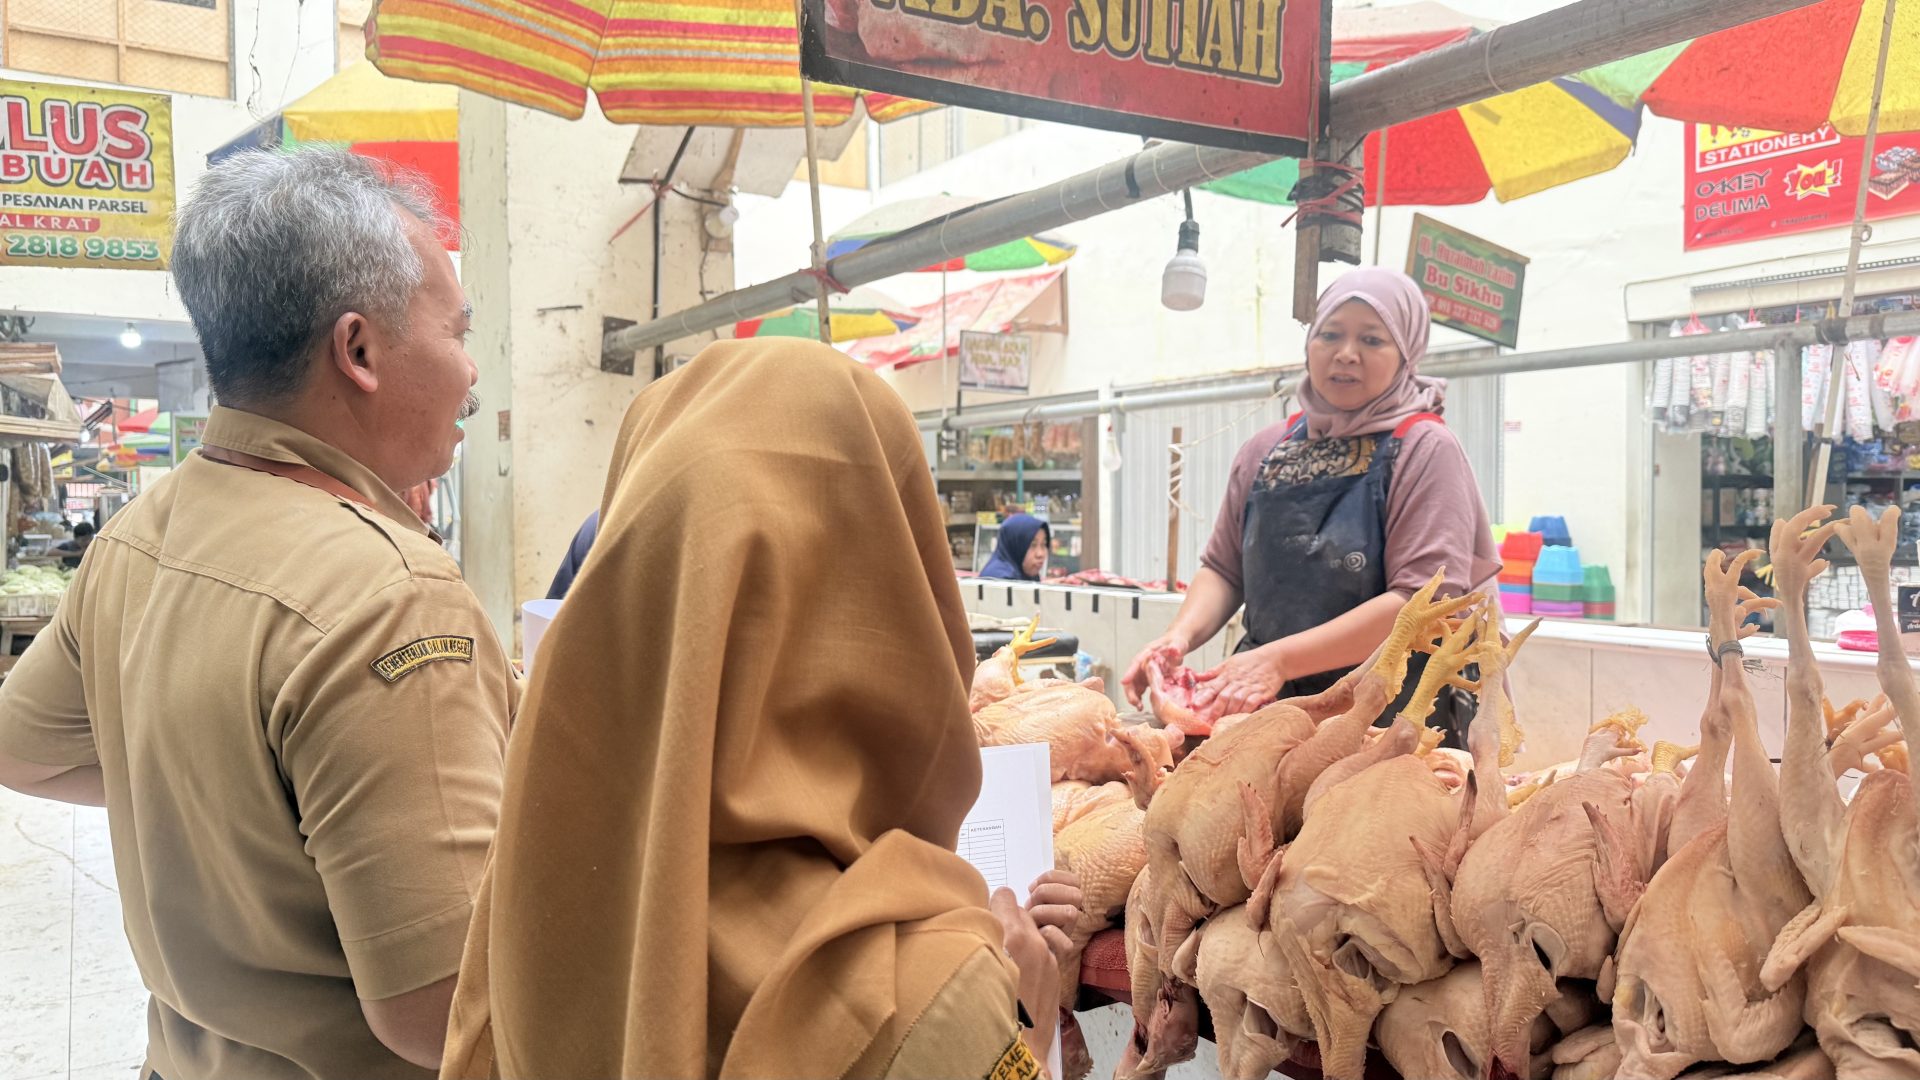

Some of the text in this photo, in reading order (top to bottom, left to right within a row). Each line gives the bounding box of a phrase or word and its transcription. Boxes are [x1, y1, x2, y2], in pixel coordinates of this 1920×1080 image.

[6, 101, 147, 160] LUS
[2, 154, 148, 186] BUAH
[2, 193, 148, 214] PESANAN PARSEL
[1695, 194, 1770, 222] DELIMA
[33, 215, 93, 231] KRAT
[7, 233, 160, 261] 2818 9853
